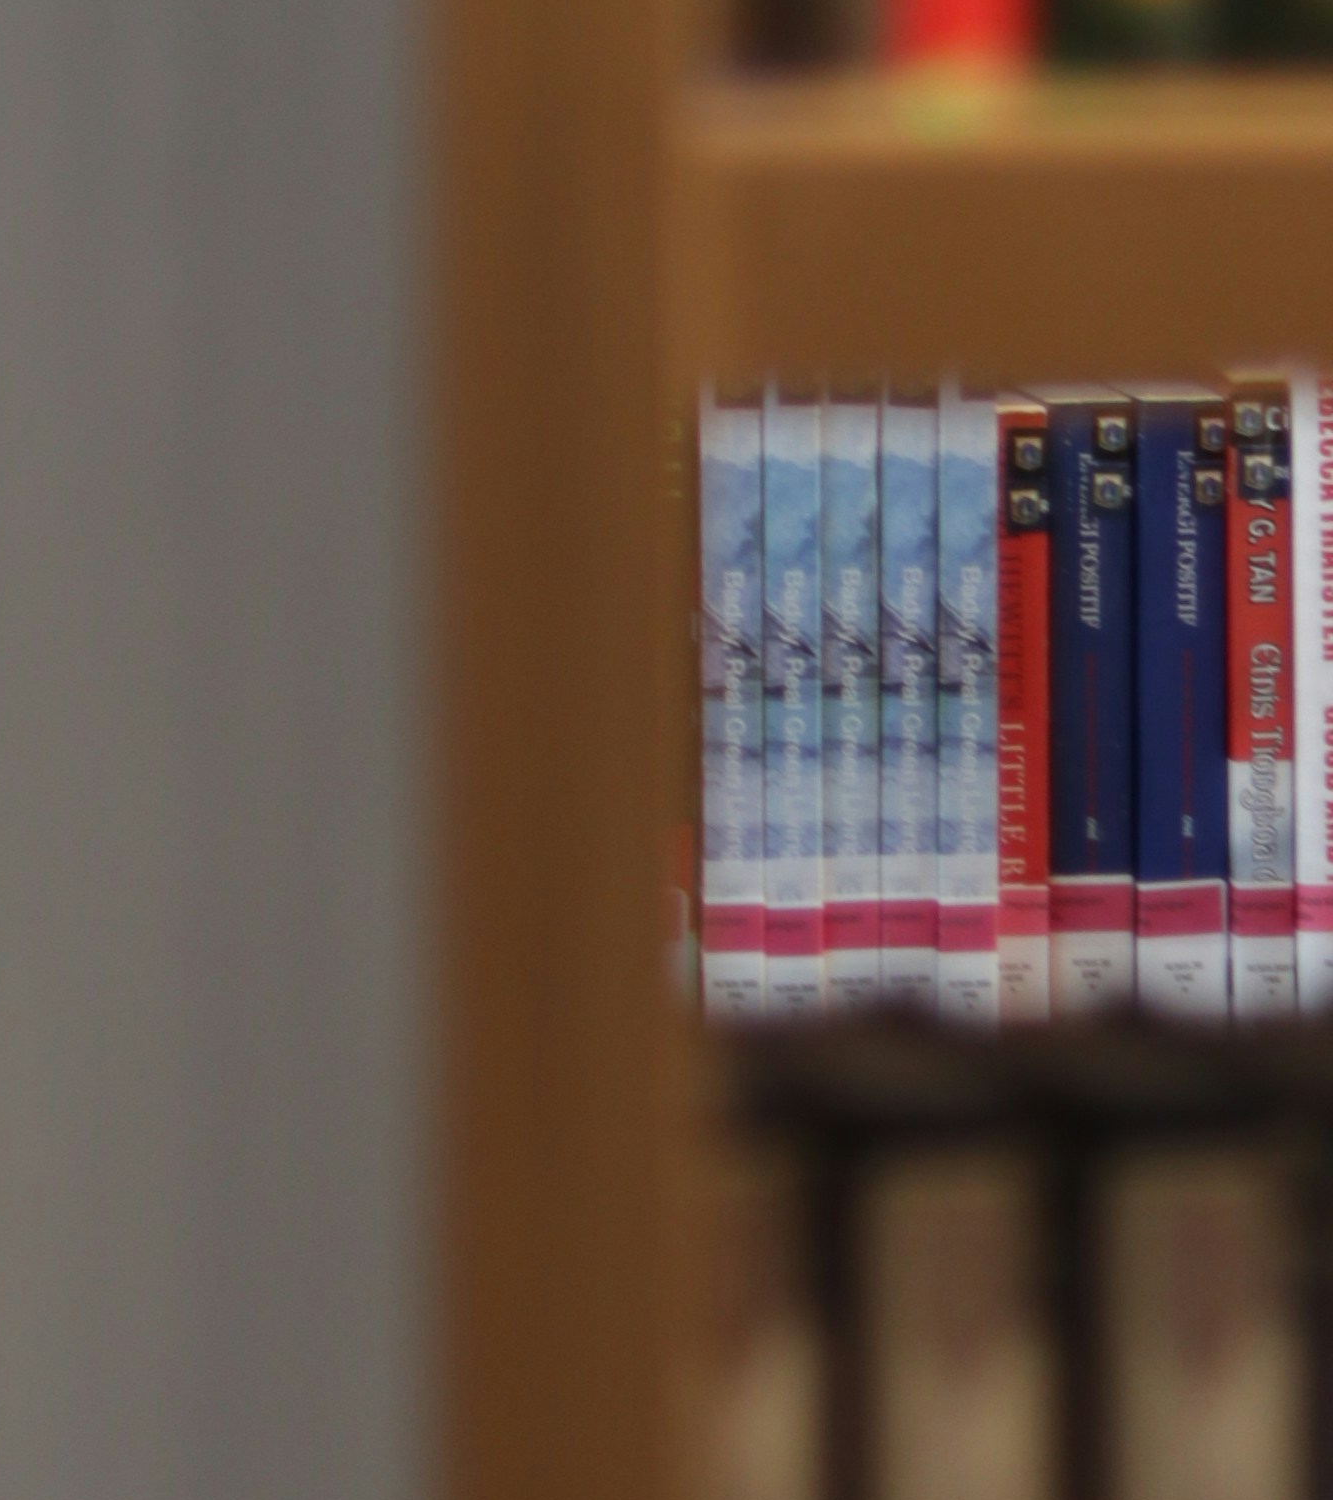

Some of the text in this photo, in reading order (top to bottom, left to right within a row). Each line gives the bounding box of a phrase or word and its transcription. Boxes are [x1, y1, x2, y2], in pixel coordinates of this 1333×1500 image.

[717, 569, 746, 646] Baduy,
[779, 569, 806, 645] Baduy,
[835, 567, 862, 644] Baduy,
[898, 566, 924, 643] Baduy,
[956, 566, 982, 643] Baduy,
[1079, 542, 1101, 630] POSITIF
[1177, 540, 1198, 628] POSITIF
[1248, 551, 1277, 604] TAN
[722, 658, 746, 710] Real
[784, 657, 806, 710] Real
[840, 656, 862, 707] Real
[903, 654, 924, 707] Real
[961, 653, 982, 706] Real
[1249, 642, 1283, 720] Etnis
[722, 717, 746, 788] Green
[784, 716, 806, 788] Green
[840, 714, 862, 786] Green
[903, 713, 924, 784] Green
[961, 712, 982, 783] Green
[999, 722, 1026, 843] LITTLE
